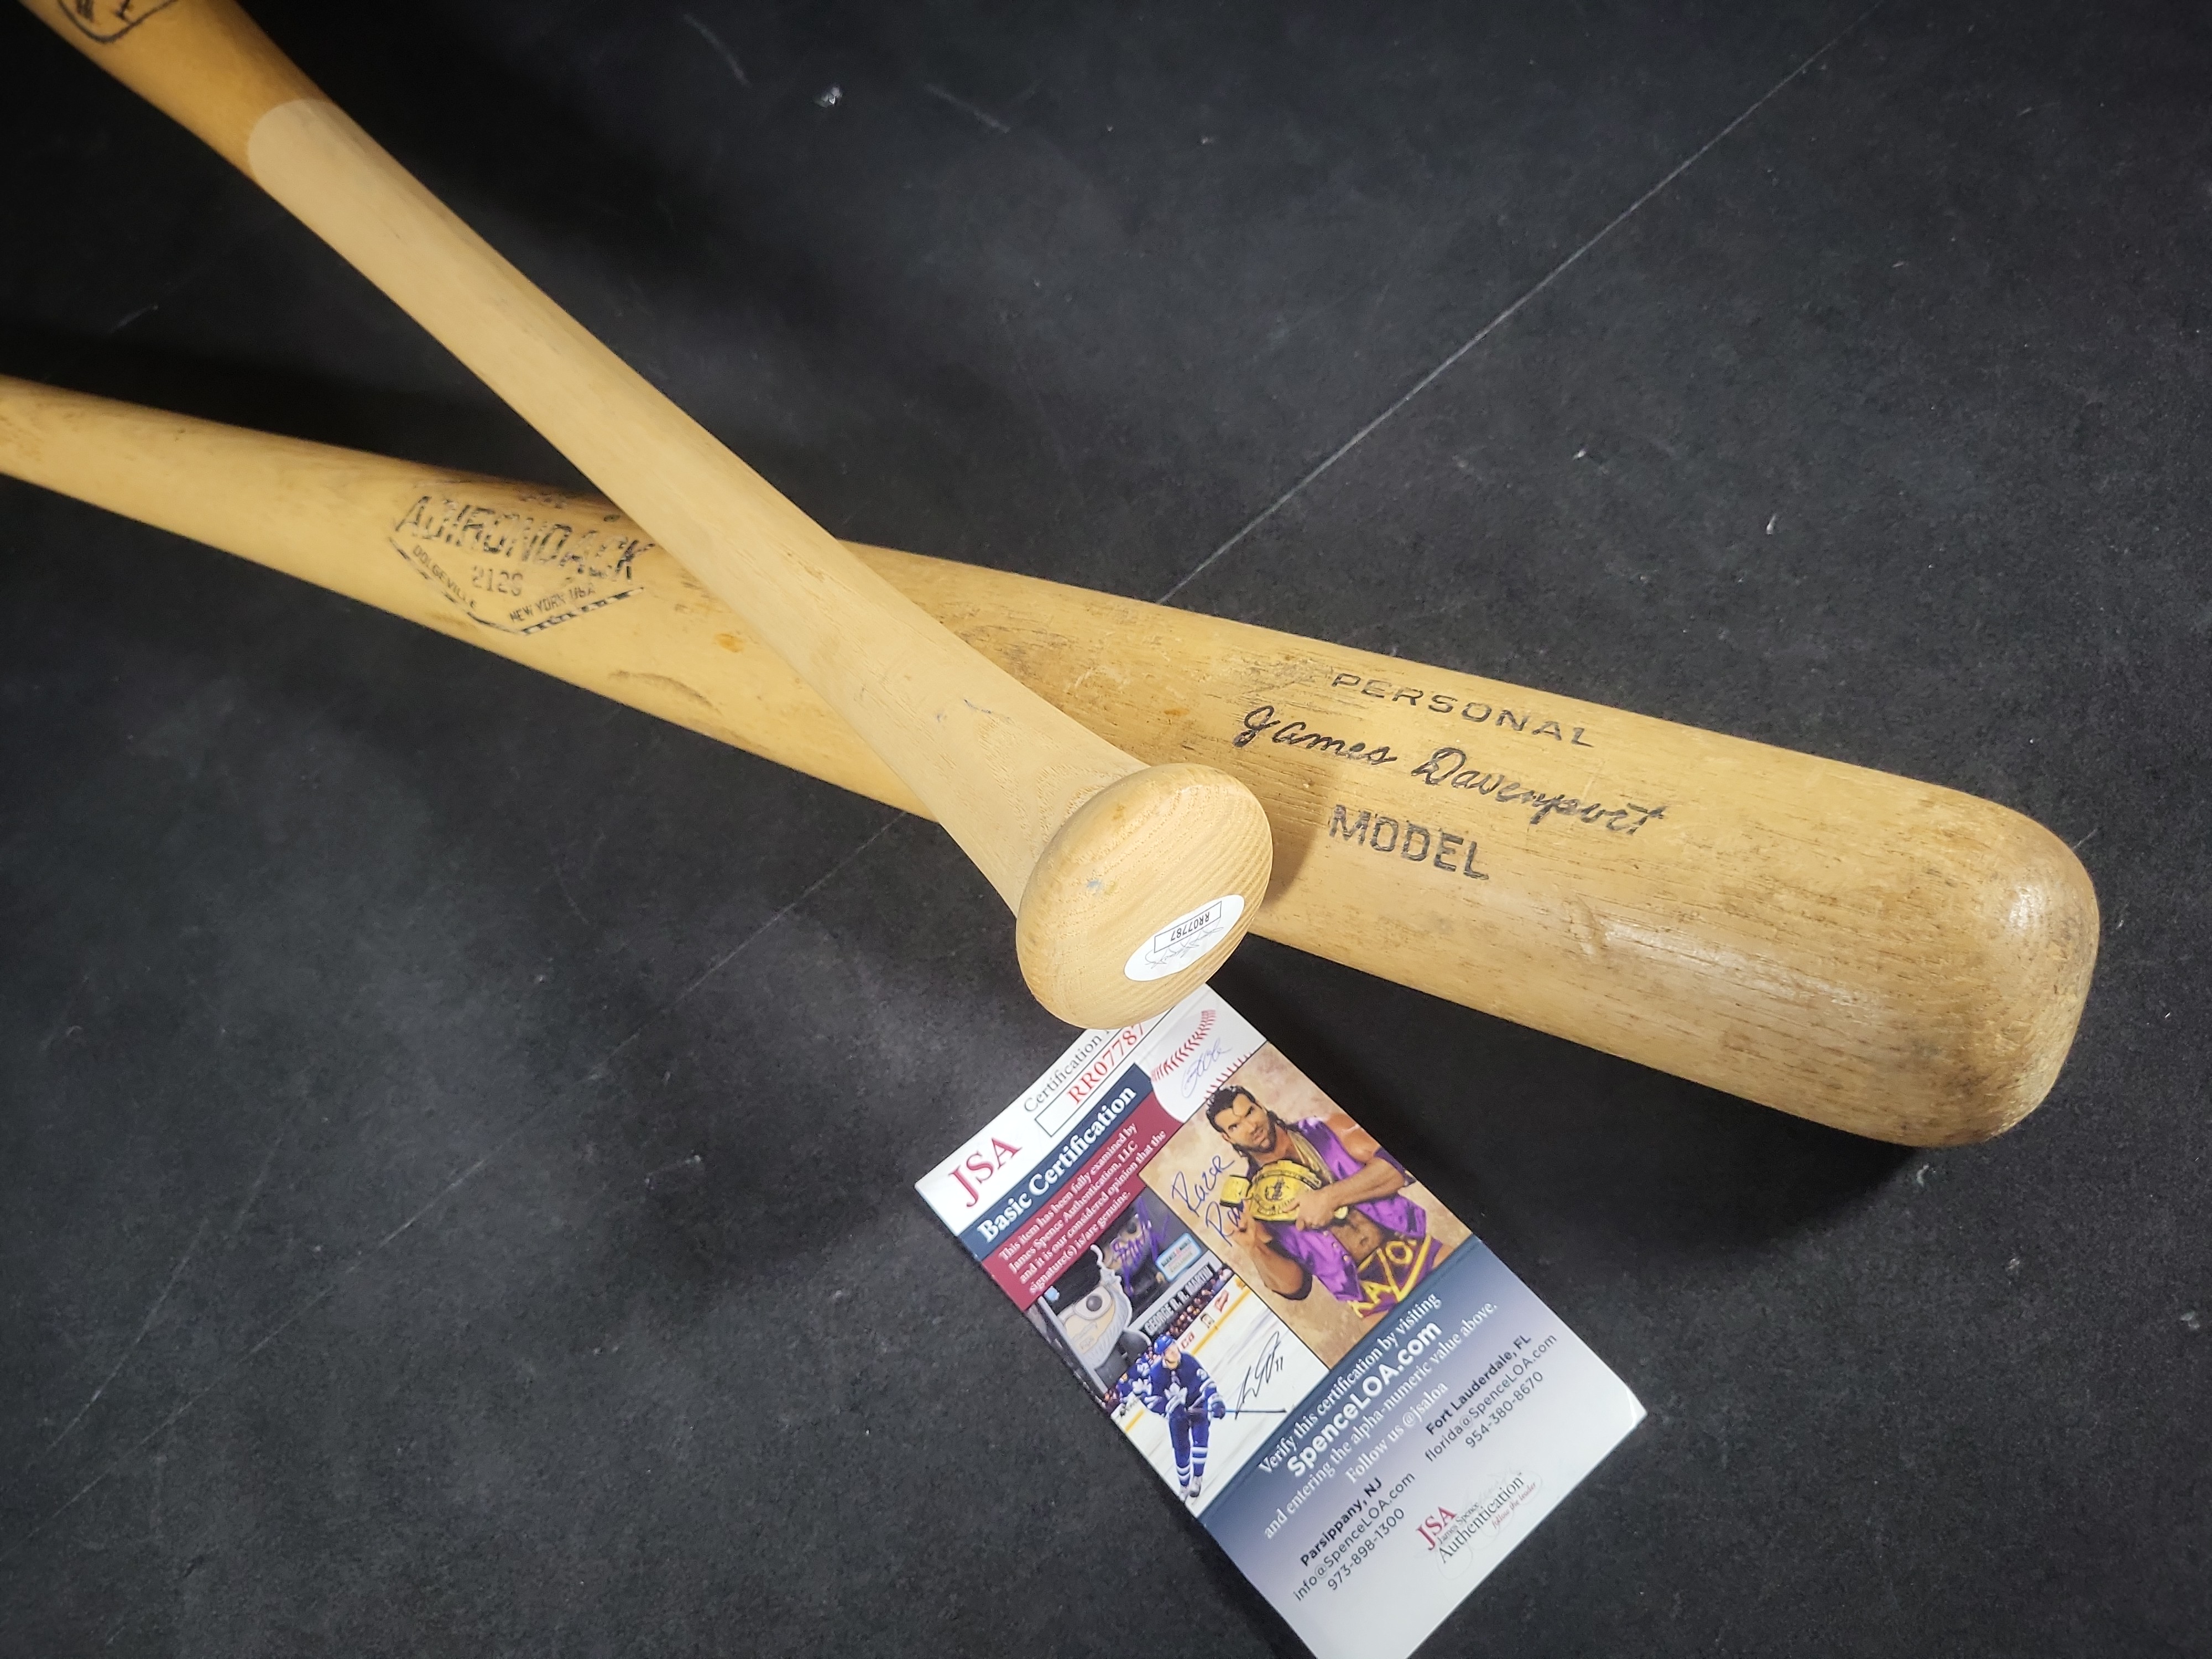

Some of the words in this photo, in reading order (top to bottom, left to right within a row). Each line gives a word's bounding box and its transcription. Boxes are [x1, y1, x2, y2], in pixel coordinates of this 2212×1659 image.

[510, 604, 534, 623] NEW
[535, 593, 566, 613] YORK
[1331, 671, 1595, 748] PERSONAL
[1233, 705, 1399, 766] James
[1411, 747, 1668, 836] Davenport
[1328, 804, 1490, 881] MODEL
[1170, 911, 1210, 942] RR07787
[1024, 1034, 1103, 1112] Certification
[1068, 1023, 1145, 1104] RR07787
[948, 1136, 1022, 1208] JSA
[977, 1192, 1033, 1243] Basic
[1029, 1086, 1138, 1196] Certification
[998, 1242, 1021, 1261] This
[1018, 1224, 1040, 1245] item
[1036, 1210, 1055, 1228] has
[1051, 1191, 1073, 1213] been
[1071, 1172, 1092, 1194] fully
[1090, 1133, 1128, 1176] examined
[1123, 1123, 1138, 1137] by
[1009, 1246, 1036, 1274] James
[1032, 1219, 1065, 1250] Spence
[1063, 1162, 1122, 1223] Authentication,
[1118, 1140, 1138, 1163] LLC
[1019, 1262, 1037, 1284] and
[1035, 1256, 1045, 1268] it
[1042, 1250, 1053, 1261] is
[1052, 1234, 1068, 1253] our
[1067, 1191, 1109, 1238] considered
[1108, 1162, 1138, 1196] opinion
[1135, 1144, 1154, 1164] that
[1151, 1130, 1166, 1147] the
[1029, 1245, 1077, 1295] signature(s)
[1074, 1223, 1099, 1249] is/are
[1097, 1191, 1131, 1230] genuine.
[1259, 1436, 1297, 1474] Verify
[1294, 1413, 1318, 1438] this
[1317, 1348, 1383, 1416] certification
[1377, 1332, 1399, 1350] by
[1395, 1293, 1442, 1334] visiting
[1264, 1508, 1288, 1540] and
[1286, 1462, 1335, 1515] entering
[1329, 1441, 1353, 1465] the
[1351, 1362, 1432, 1444] alpha-numeric
[1430, 1333, 1462, 1364] value
[1460, 1303, 1498, 1337] above.
[1287, 1322, 1442, 1478] SpenceLOA.com
[1345, 1439, 1389, 1484] Follow
[1387, 1425, 1405, 1442] us
[1402, 1381, 1449, 1428] @jsaloa
[1425, 1408, 1453, 1436] Fort
[1450, 1351, 1517, 1411] Lauderdale,
[1513, 1334, 1532, 1350] FL
[1425, 1335, 1558, 1462] florida@SpenceLOA.com
[1465, 1371, 1543, 1448] 954-380-8670
[1293, 1473, 1416, 1601] info@SpenceLOA.com
[1300, 1498, 1368, 1567] Parsippany,
[1364, 1477, 1383, 1498] NJ
[1328, 1508, 1405, 1591] 973-898-1300
[1416, 1506, 1457, 1551] JSA
[1439, 1475, 1525, 1564] Authentication
